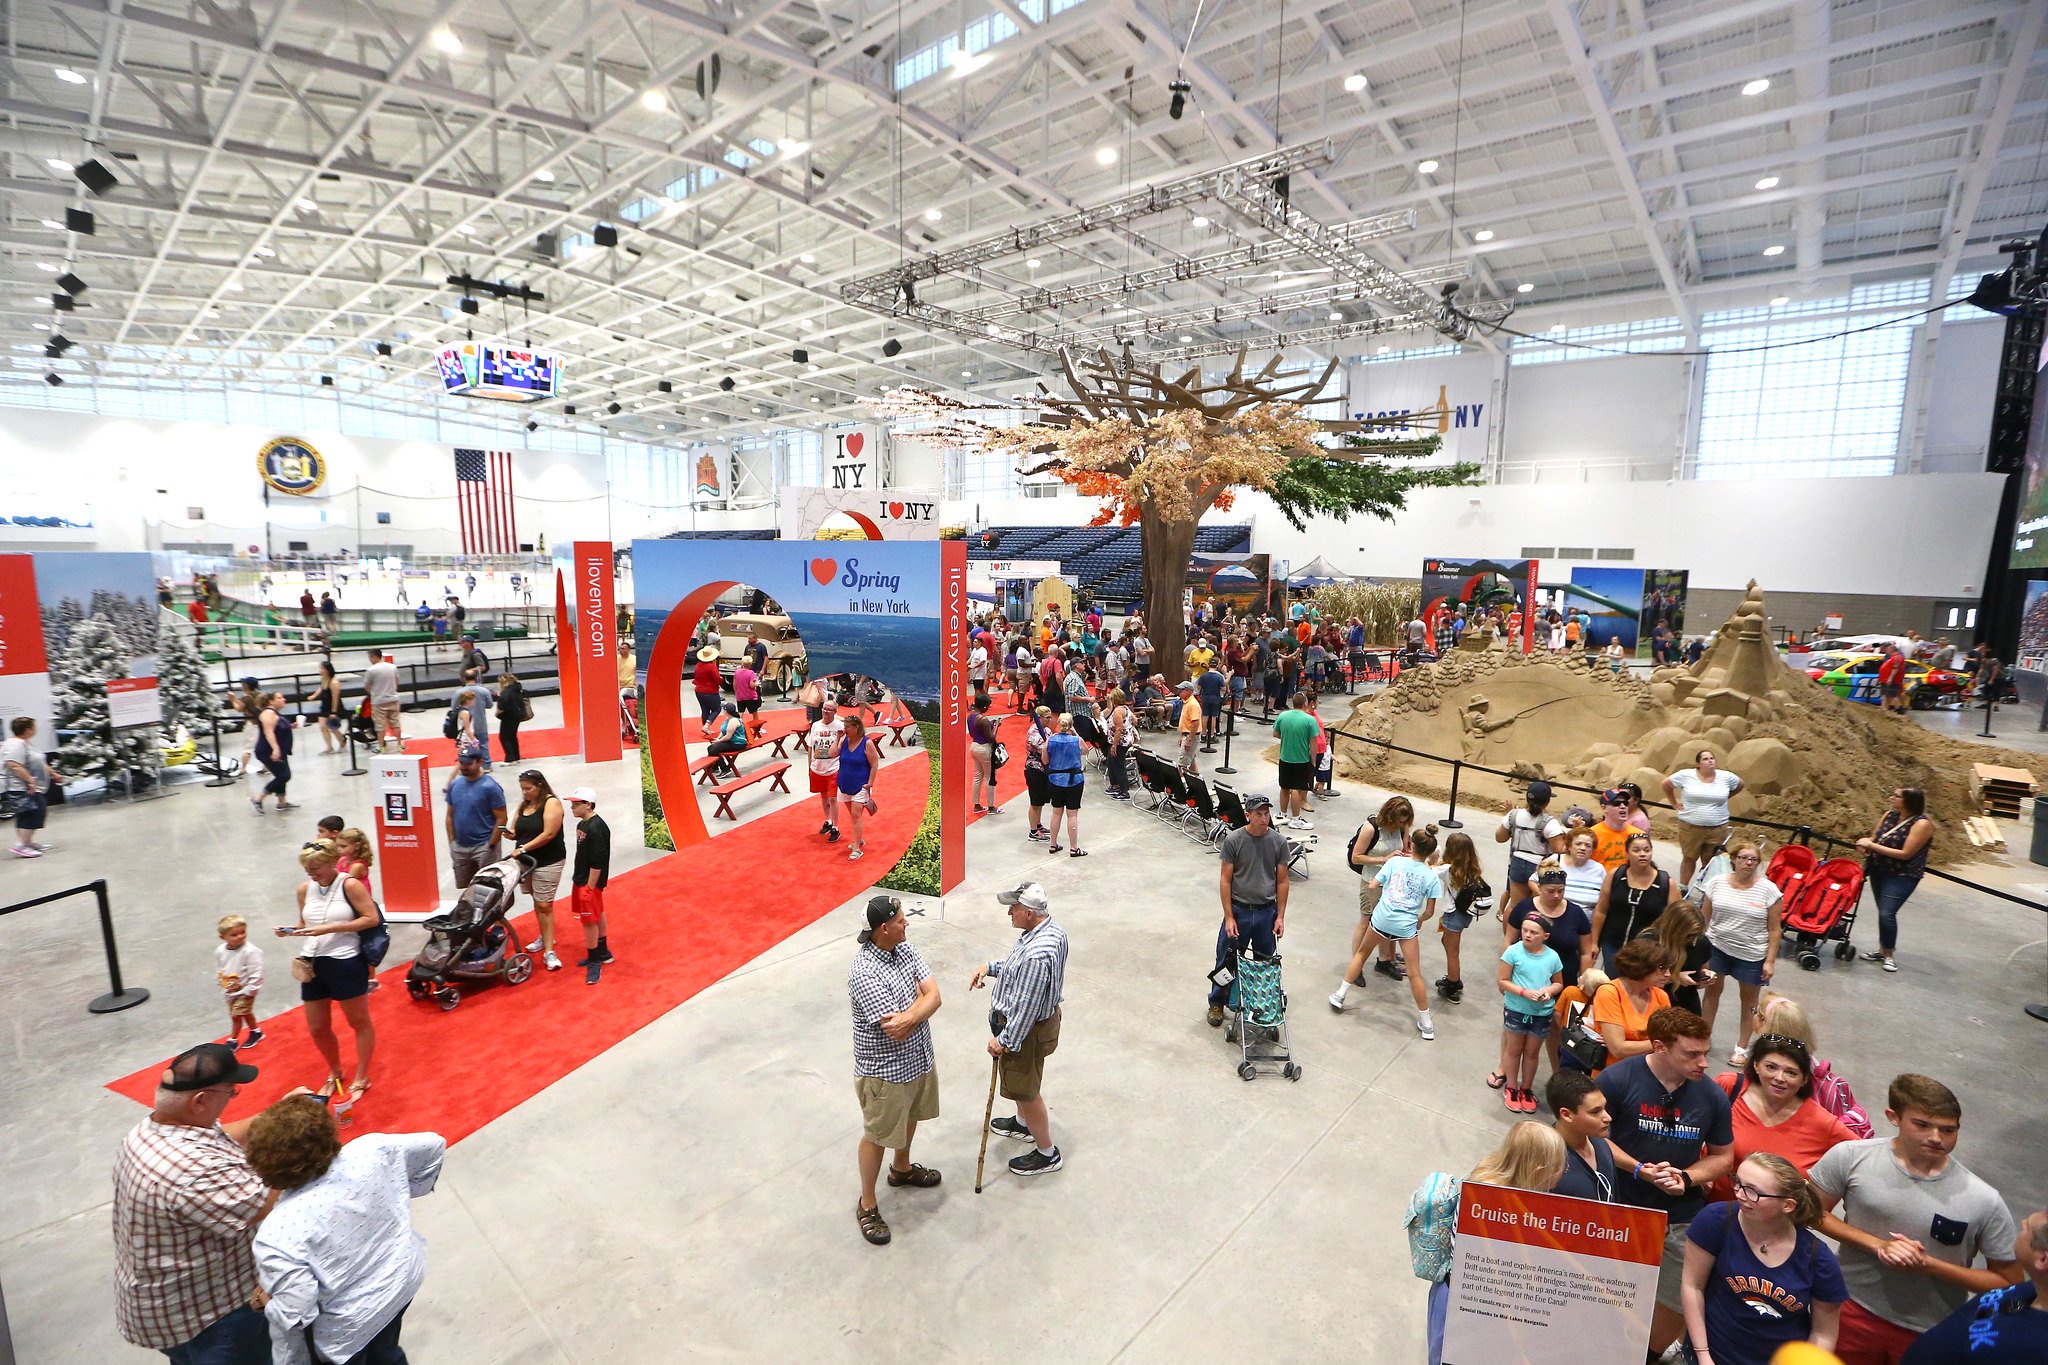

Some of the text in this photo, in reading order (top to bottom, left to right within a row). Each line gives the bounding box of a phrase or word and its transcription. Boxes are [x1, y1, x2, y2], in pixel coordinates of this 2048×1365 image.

[1455, 404, 1483, 428] NY
[836, 434, 845, 459] I
[832, 463, 866, 489] NY
[880, 501, 934, 520] I NY
[841, 558, 900, 593] Spring
[1529, 566, 1537, 617] iloveny.com
[586, 558, 604, 657] iloveny.com
[849, 599, 910, 614] in New York
[948, 568, 961, 725] iloveny.com
[1470, 1203, 1630, 1243] Cruise the Erie Canal
[1464, 1262, 1478, 1271] Drift
[1479, 1266, 1496, 1274] under
[1498, 1270, 1532, 1280] century-old
[1534, 1274, 1542, 1282] lift
[1570, 1281, 1593, 1292] Sample
[1606, 1287, 1627, 1298] beauty
[1629, 1291, 1636, 1299] of
[1465, 1253, 1480, 1262] Rent
[1487, 1257, 1500, 1265] boat
[1501, 1260, 1512, 1268] and
[1514, 1263, 1536, 1272] explore
[1537, 1265, 1568, 1277] America's
[1569, 1272, 1585, 1280] most
[1586, 1274, 1605, 1283] iconic
[1462, 1282, 1474, 1291] part
[1483, 1285, 1493, 1294] the
[1494, 1287, 1515, 1298] legend
[1524, 1293, 1533, 1301] the
[1535, 1295, 1546, 1303] Erie
[1548, 1297, 1567, 1307] Canal!
[1463, 1272, 1485, 1282] historic
[1504, 1280, 1523, 1289] towns.
[1526, 1282, 1534, 1291] Tie
[1558, 1290, 1580, 1299] explore
[1582, 1294, 1596, 1302] wine
[1625, 1300, 1633, 1308] Be
[1726, 1276, 1804, 1312] BRONCOS
[1460, 1306, 1476, 1314] Special
[1524, 1318, 1548, 1327] Navigation
